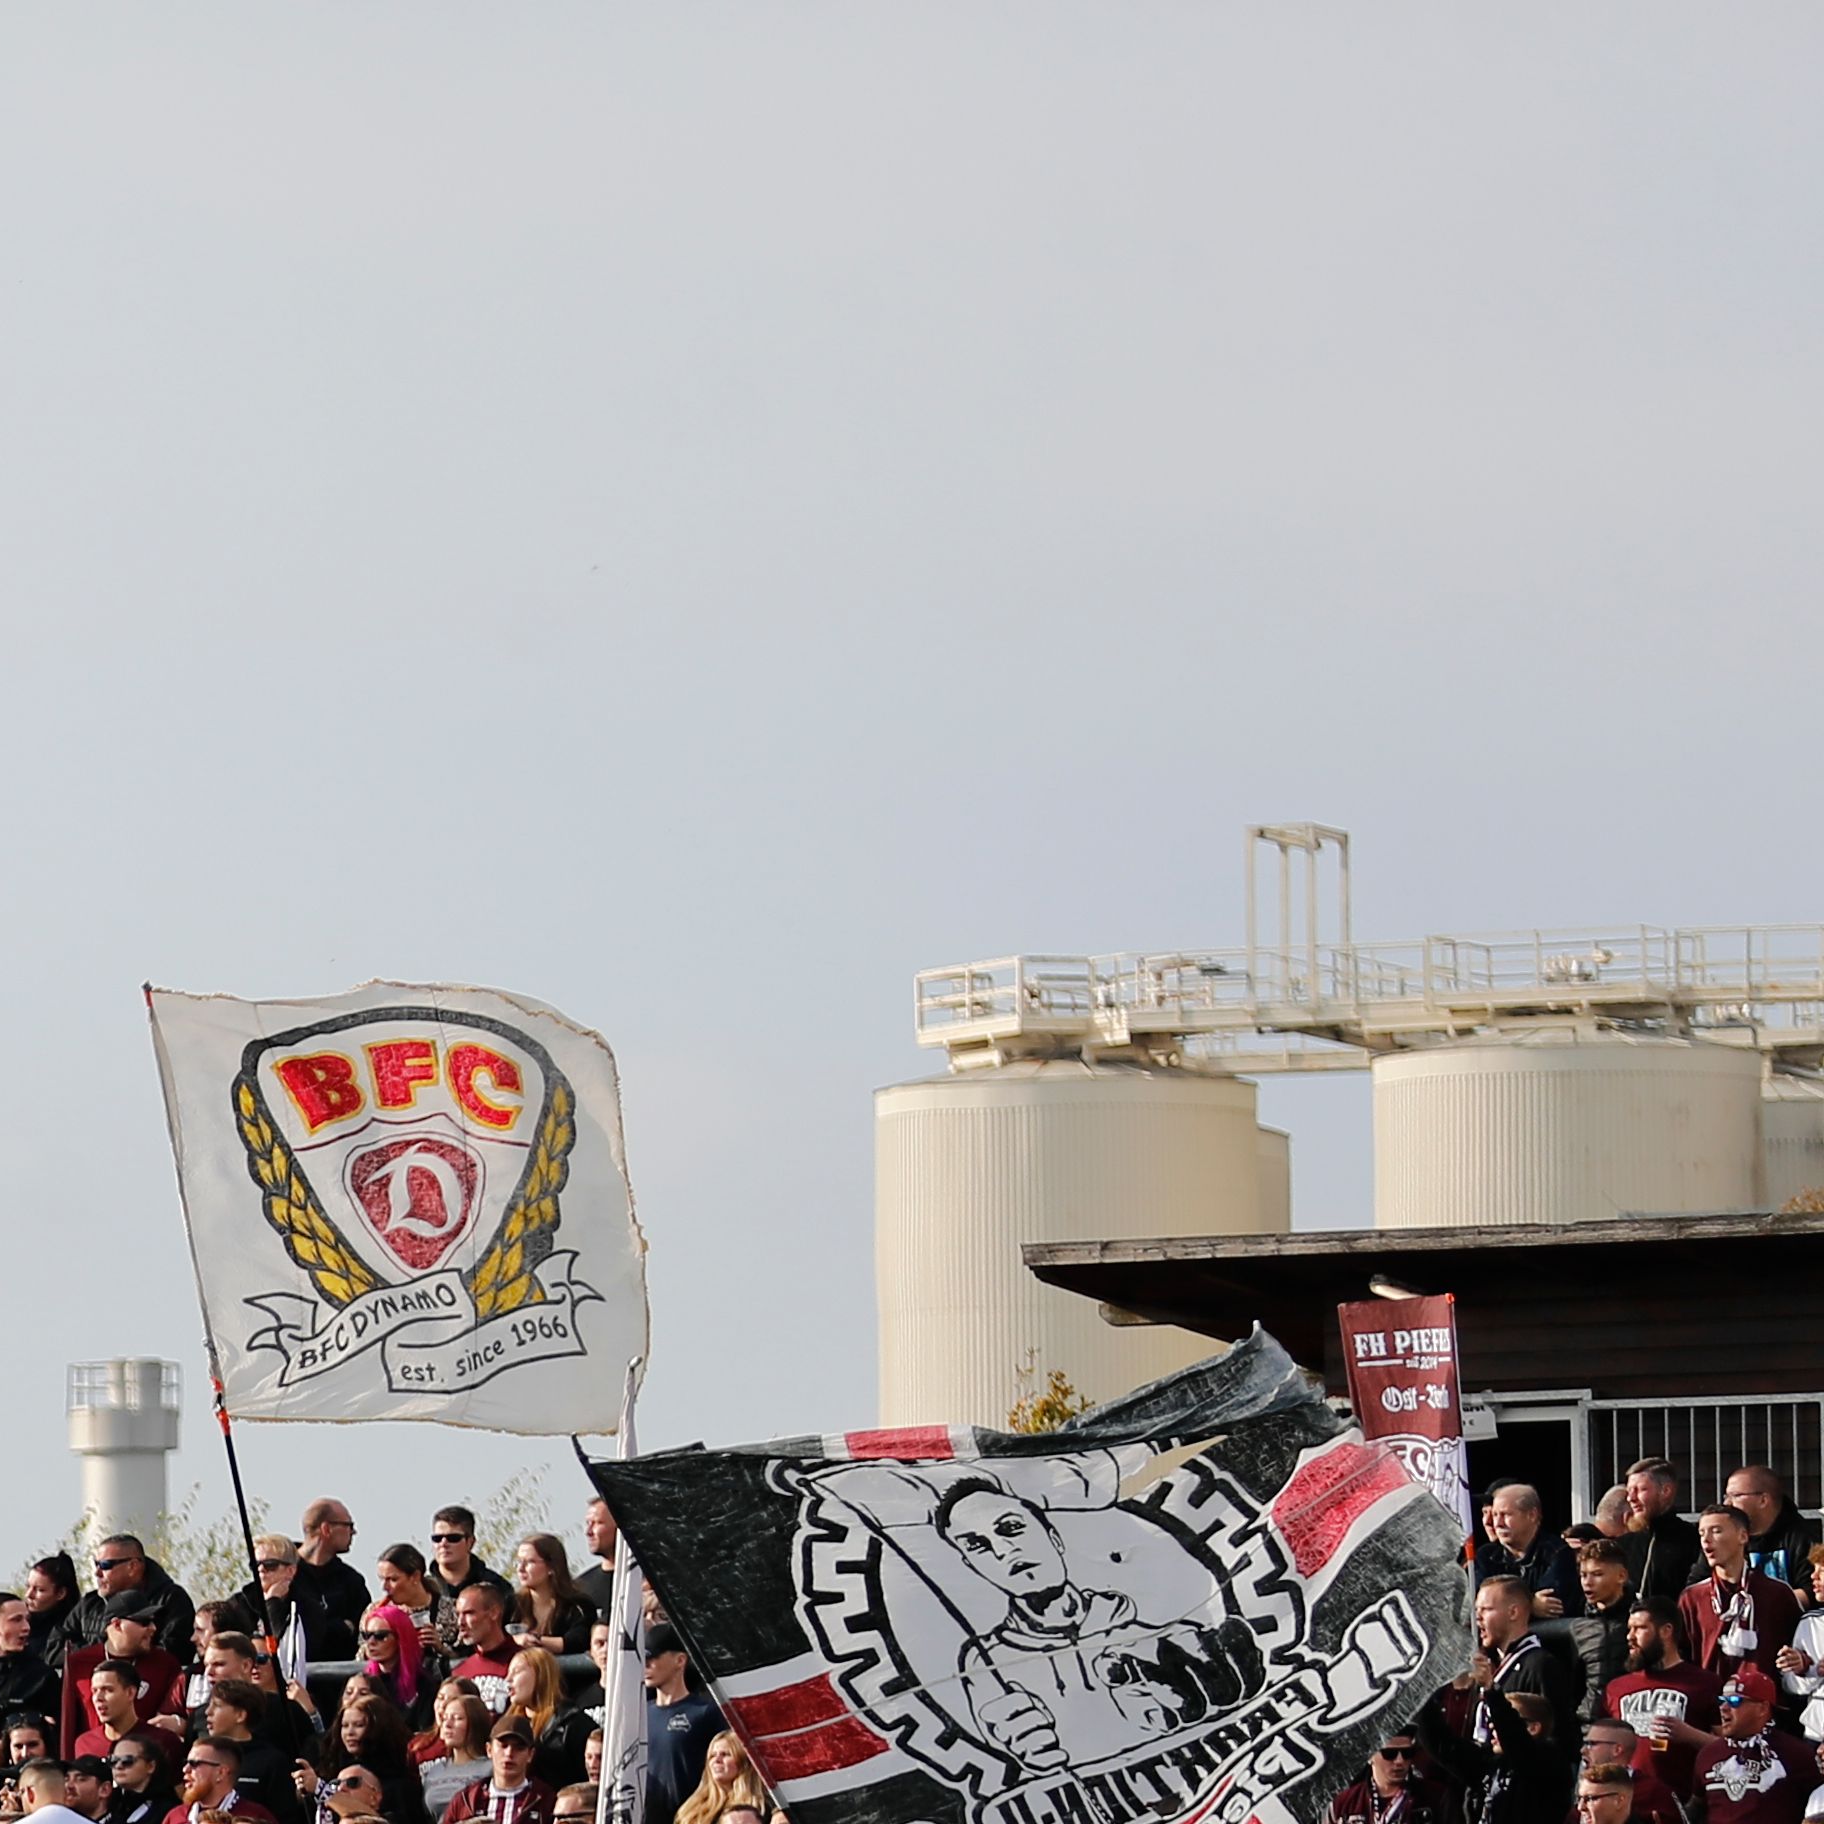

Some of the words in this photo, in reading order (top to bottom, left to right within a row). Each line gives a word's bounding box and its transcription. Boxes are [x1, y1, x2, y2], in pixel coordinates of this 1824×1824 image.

[271, 1038, 525, 1134] BFC
[296, 1321, 349, 1370] BFC
[354, 1283, 458, 1339] DYNAMO
[400, 1364, 446, 1383] est.
[456, 1341, 506, 1377] since
[511, 1318, 569, 1351] 1966
[1353, 1333, 1387, 1357] FH
